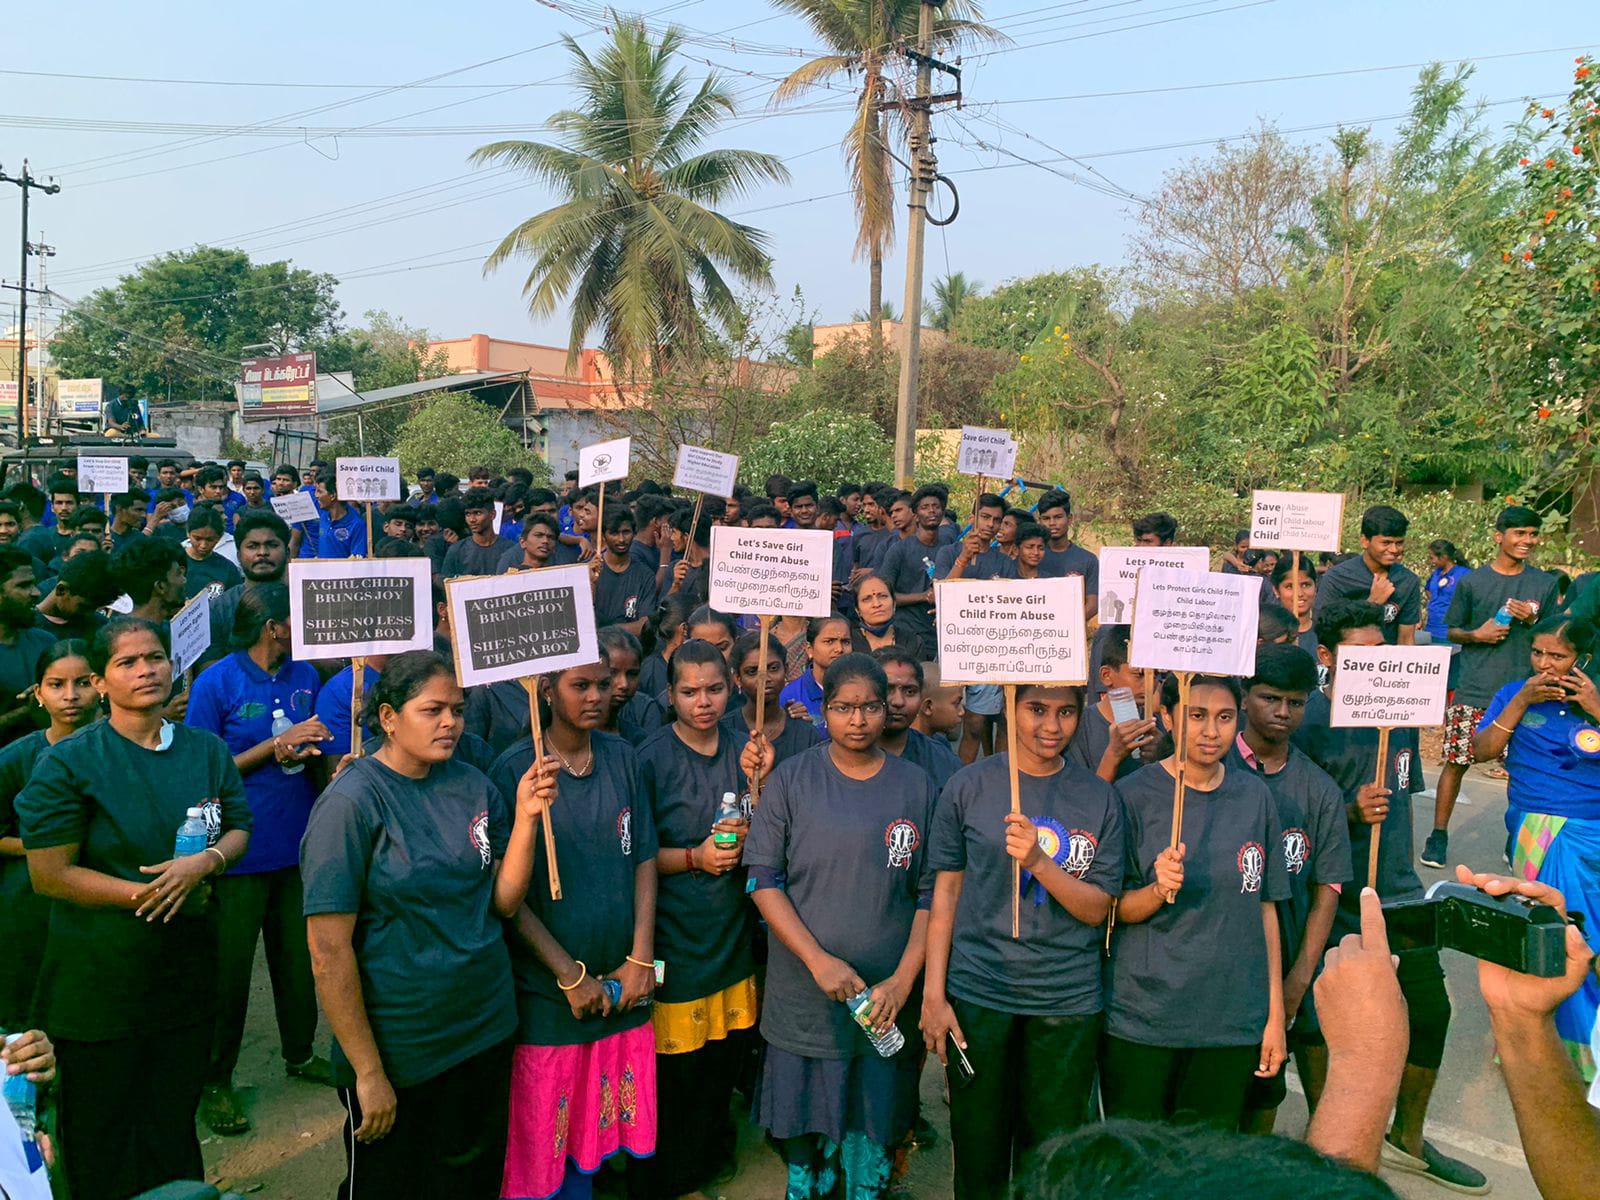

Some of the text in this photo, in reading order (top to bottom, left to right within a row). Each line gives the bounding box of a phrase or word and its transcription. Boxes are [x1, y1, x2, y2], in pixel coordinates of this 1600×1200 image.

[990, 437, 1006, 445] Child
[340, 464, 358, 472] Save
[1256, 502, 1280, 512] Save
[1286, 504, 1309, 512] Abuse
[1258, 516, 1277, 526] Girl
[1254, 530, 1280, 540] Child
[1283, 530, 1330, 540] Child Marriage
[738, 538, 803, 552] Let's Save Girl
[730, 551, 809, 566] Child From Abuse
[1126, 558, 1184, 568] Lets Protect
[717, 561, 819, 581] பெண்குழந்தையை
[308, 578, 409, 590] A GIRL CHILD
[1167, 584, 1190, 593] Protect
[316, 590, 404, 603] BRINGS JOY
[470, 589, 569, 611] A GIRL CHILD
[725, 594, 804, 610] பாதுகாப்போம்
[968, 594, 1046, 605] Let's Save Girl
[1195, 598, 1216, 606] Labour
[479, 602, 565, 624] BRINGS JOY
[960, 609, 1055, 620] Child From Abuse
[306, 616, 413, 629] SHE'S NO LESS
[314, 628, 404, 641] THAN A BOY
[946, 623, 1069, 640] பெண்குழந்தையை
[473, 627, 576, 653] SHE'S NO LESS
[483, 642, 570, 665] THAN A BOY
[1173, 645, 1213, 654] காப்போம்
[959, 660, 1052, 674] பாதுகாப்போம்
[1343, 659, 1440, 675] Save Girl Child
[1342, 692, 1430, 707] குழந்தைகளை
